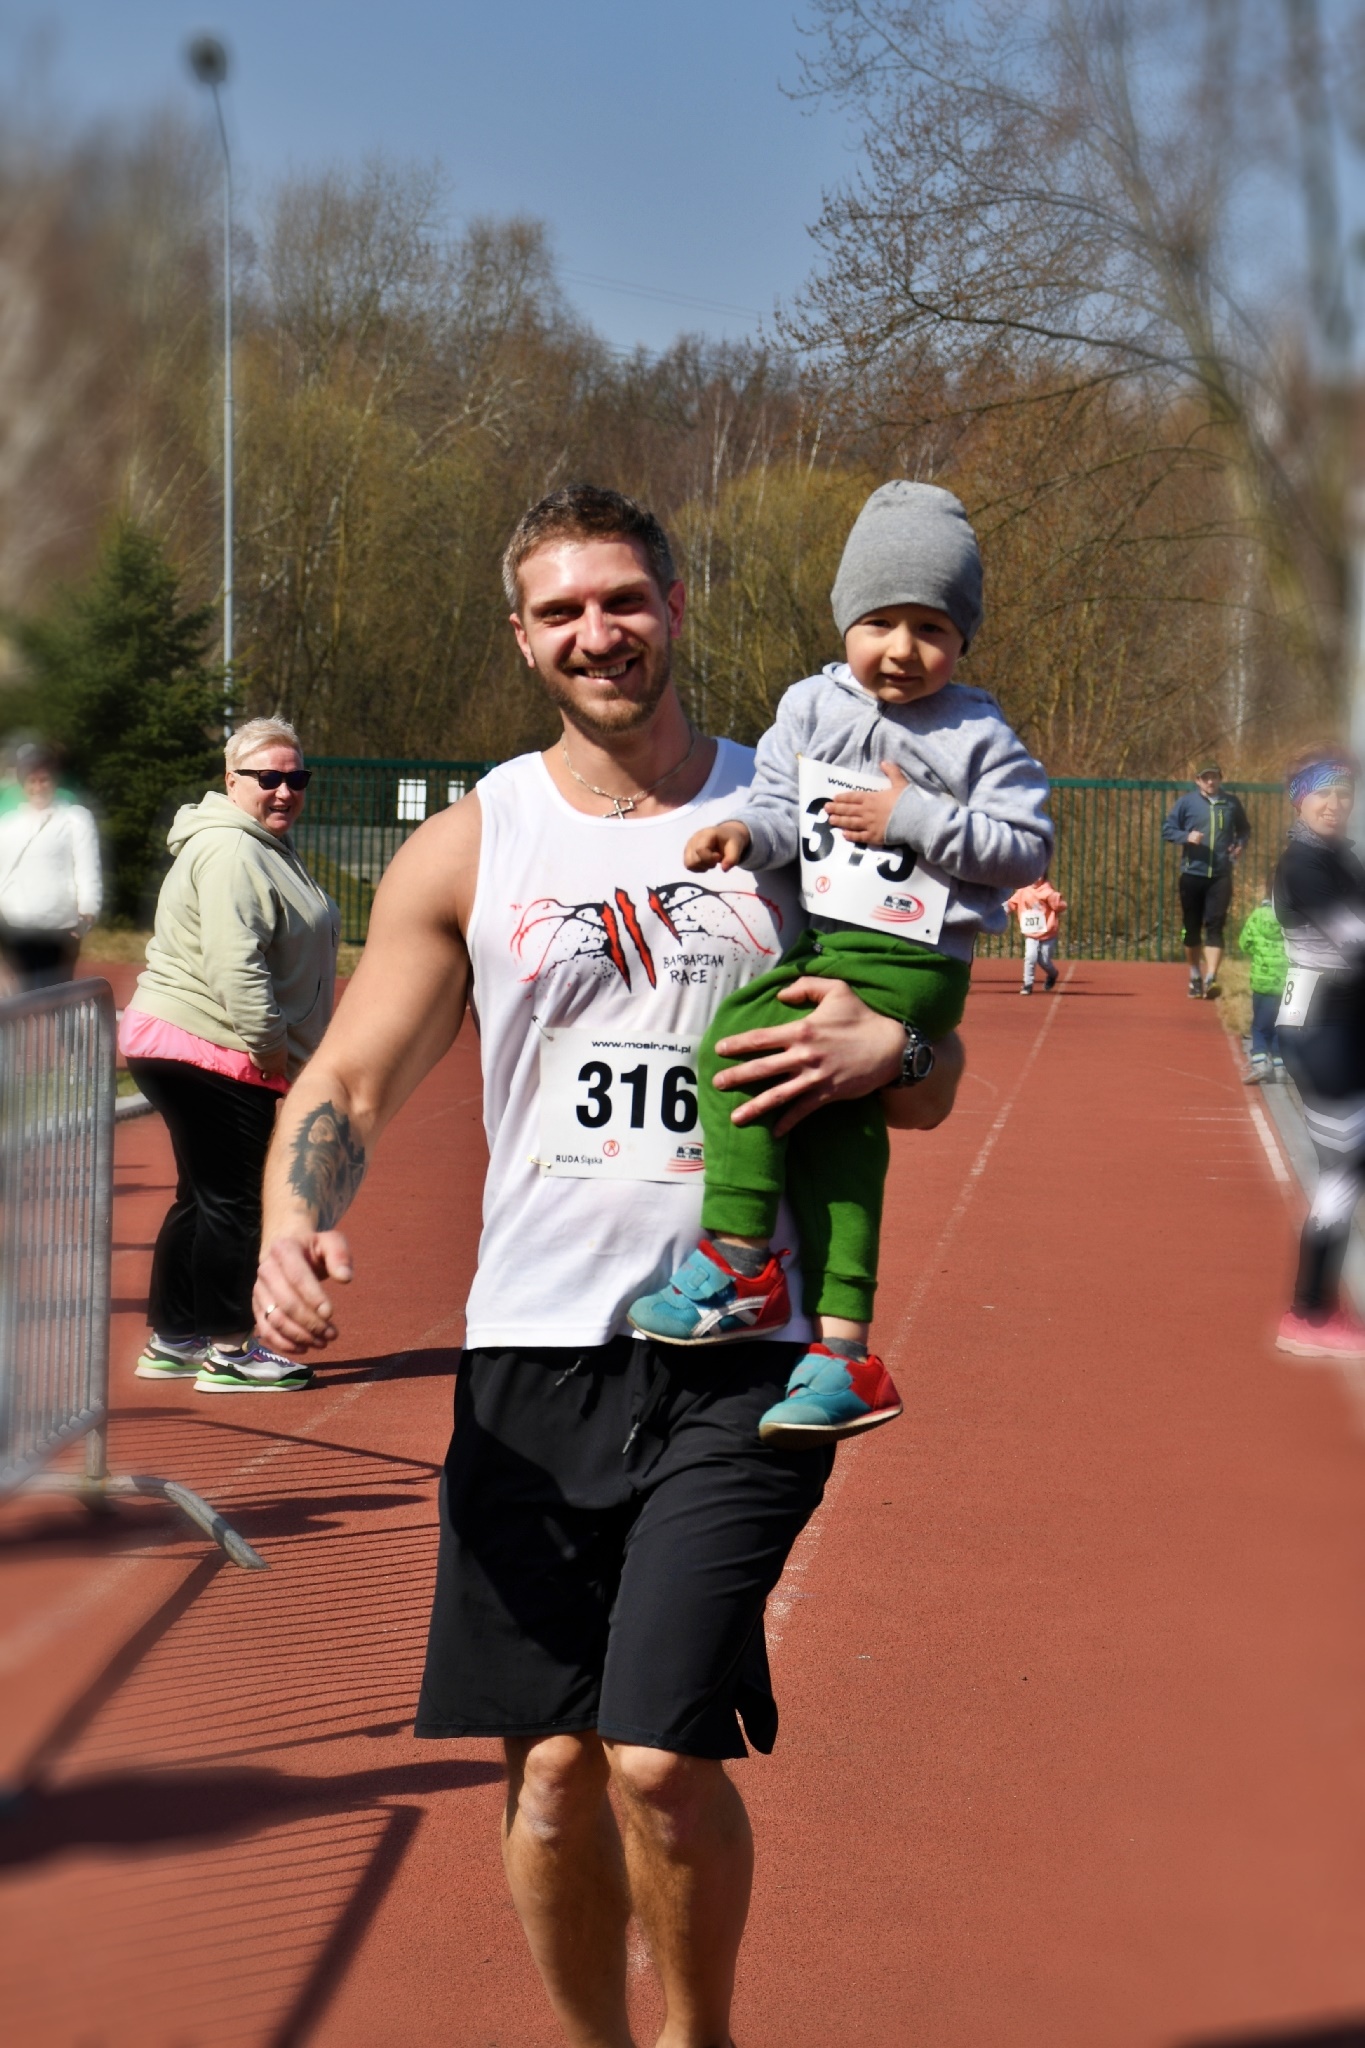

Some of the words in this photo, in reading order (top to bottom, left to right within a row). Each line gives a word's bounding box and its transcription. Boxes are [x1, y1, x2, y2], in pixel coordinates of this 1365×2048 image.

[663, 954, 725, 969] BARBARIAN
[669, 969, 707, 985] RACE
[576, 1061, 698, 1133] 316
[556, 1154, 579, 1163] RUDA
